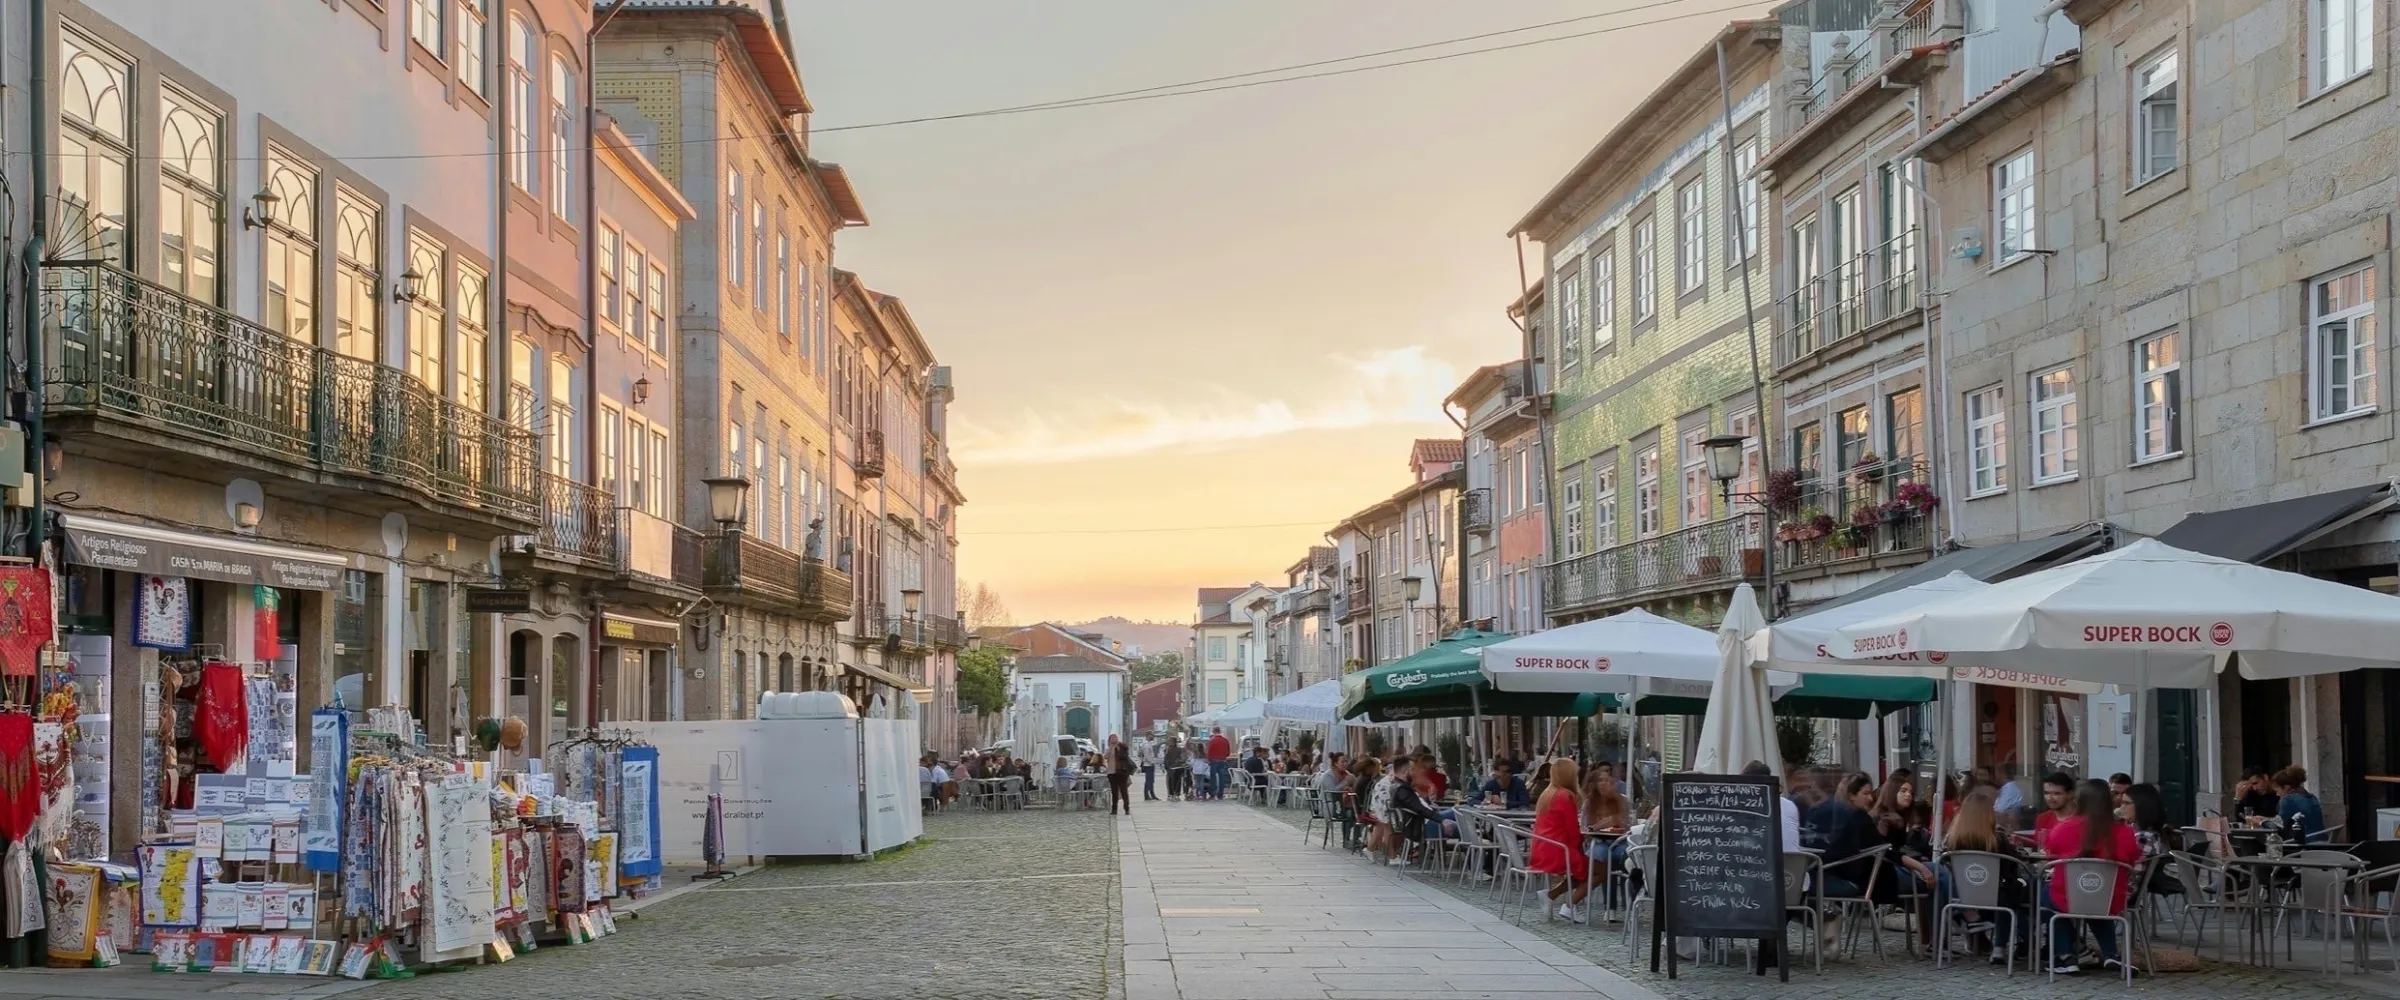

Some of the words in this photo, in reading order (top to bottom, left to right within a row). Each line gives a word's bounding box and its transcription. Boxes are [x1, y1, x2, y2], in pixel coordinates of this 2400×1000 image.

[81, 534, 109, 551] Artigos
[110, 538, 147, 555] Religiosos
[171, 556, 190, 568] CASA
[203, 560, 224, 573] MARIA
[231, 564, 252, 576] BRAGA
[1853, 635, 1875, 653] SUPER
[1875, 633, 1897, 649] BOCK
[2083, 625, 2144, 643] SUPER
[2147, 625, 2202, 643] BOCK
[1515, 657, 1553, 669] SUPER
[1556, 658, 1590, 670] BOCK
[1386, 670, 1428, 690] Carlsberg
